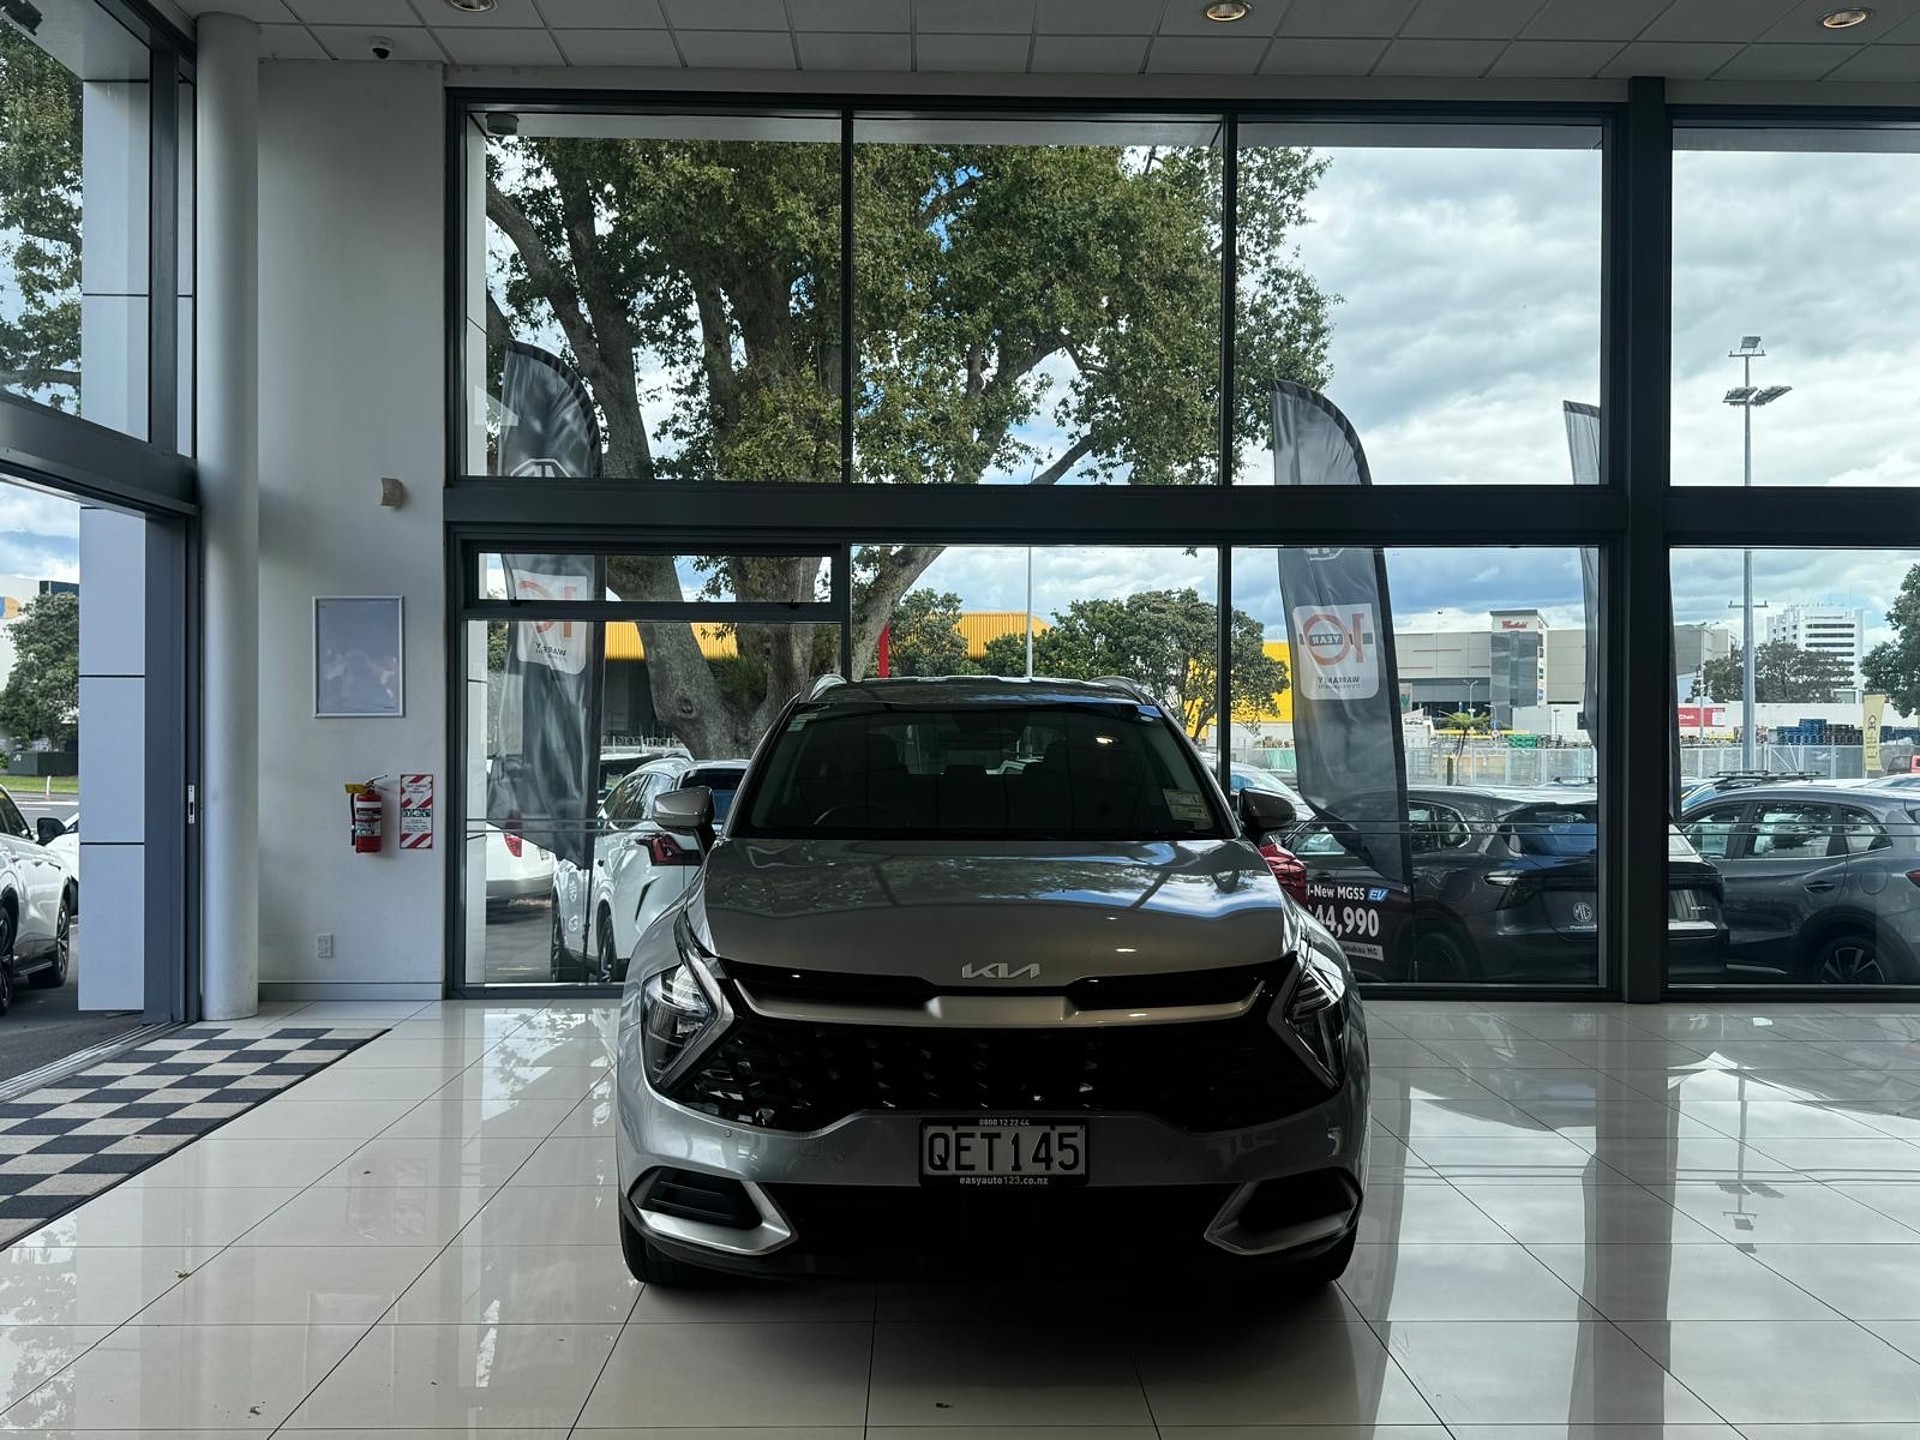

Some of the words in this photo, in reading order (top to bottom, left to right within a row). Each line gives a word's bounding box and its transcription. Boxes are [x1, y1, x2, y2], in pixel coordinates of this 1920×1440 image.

[1337, 886, 1365, 900] MGS5
[1369, 889, 1387, 901] EV
[1308, 904, 1380, 938] 44,990
[962, 962, 1040, 979] KIA
[959, 1176, 1049, 1187] easyauto123.co.nz
